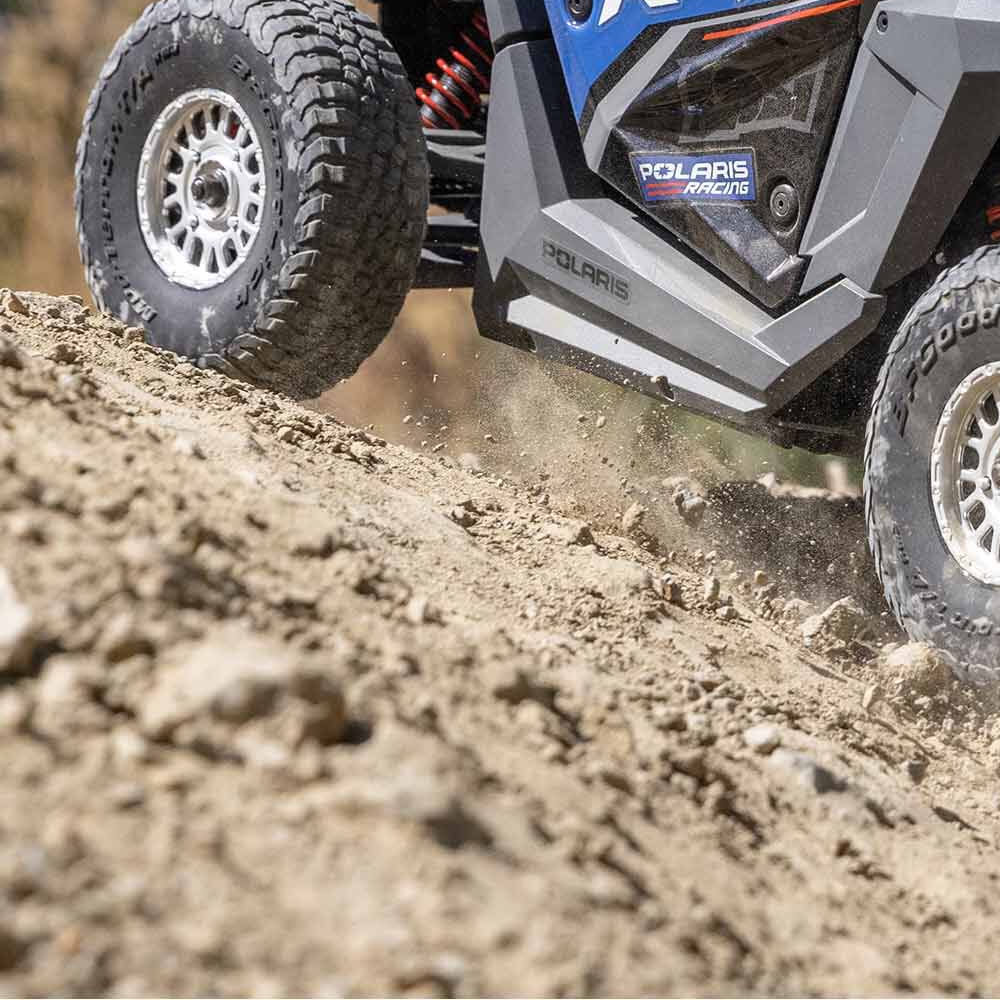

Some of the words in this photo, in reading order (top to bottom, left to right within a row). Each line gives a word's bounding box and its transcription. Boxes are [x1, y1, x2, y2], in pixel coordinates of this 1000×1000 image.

[639, 160, 749, 181] POLARIS
[681, 181, 750, 196] RACING
[541, 240, 630, 302] POLARIS
